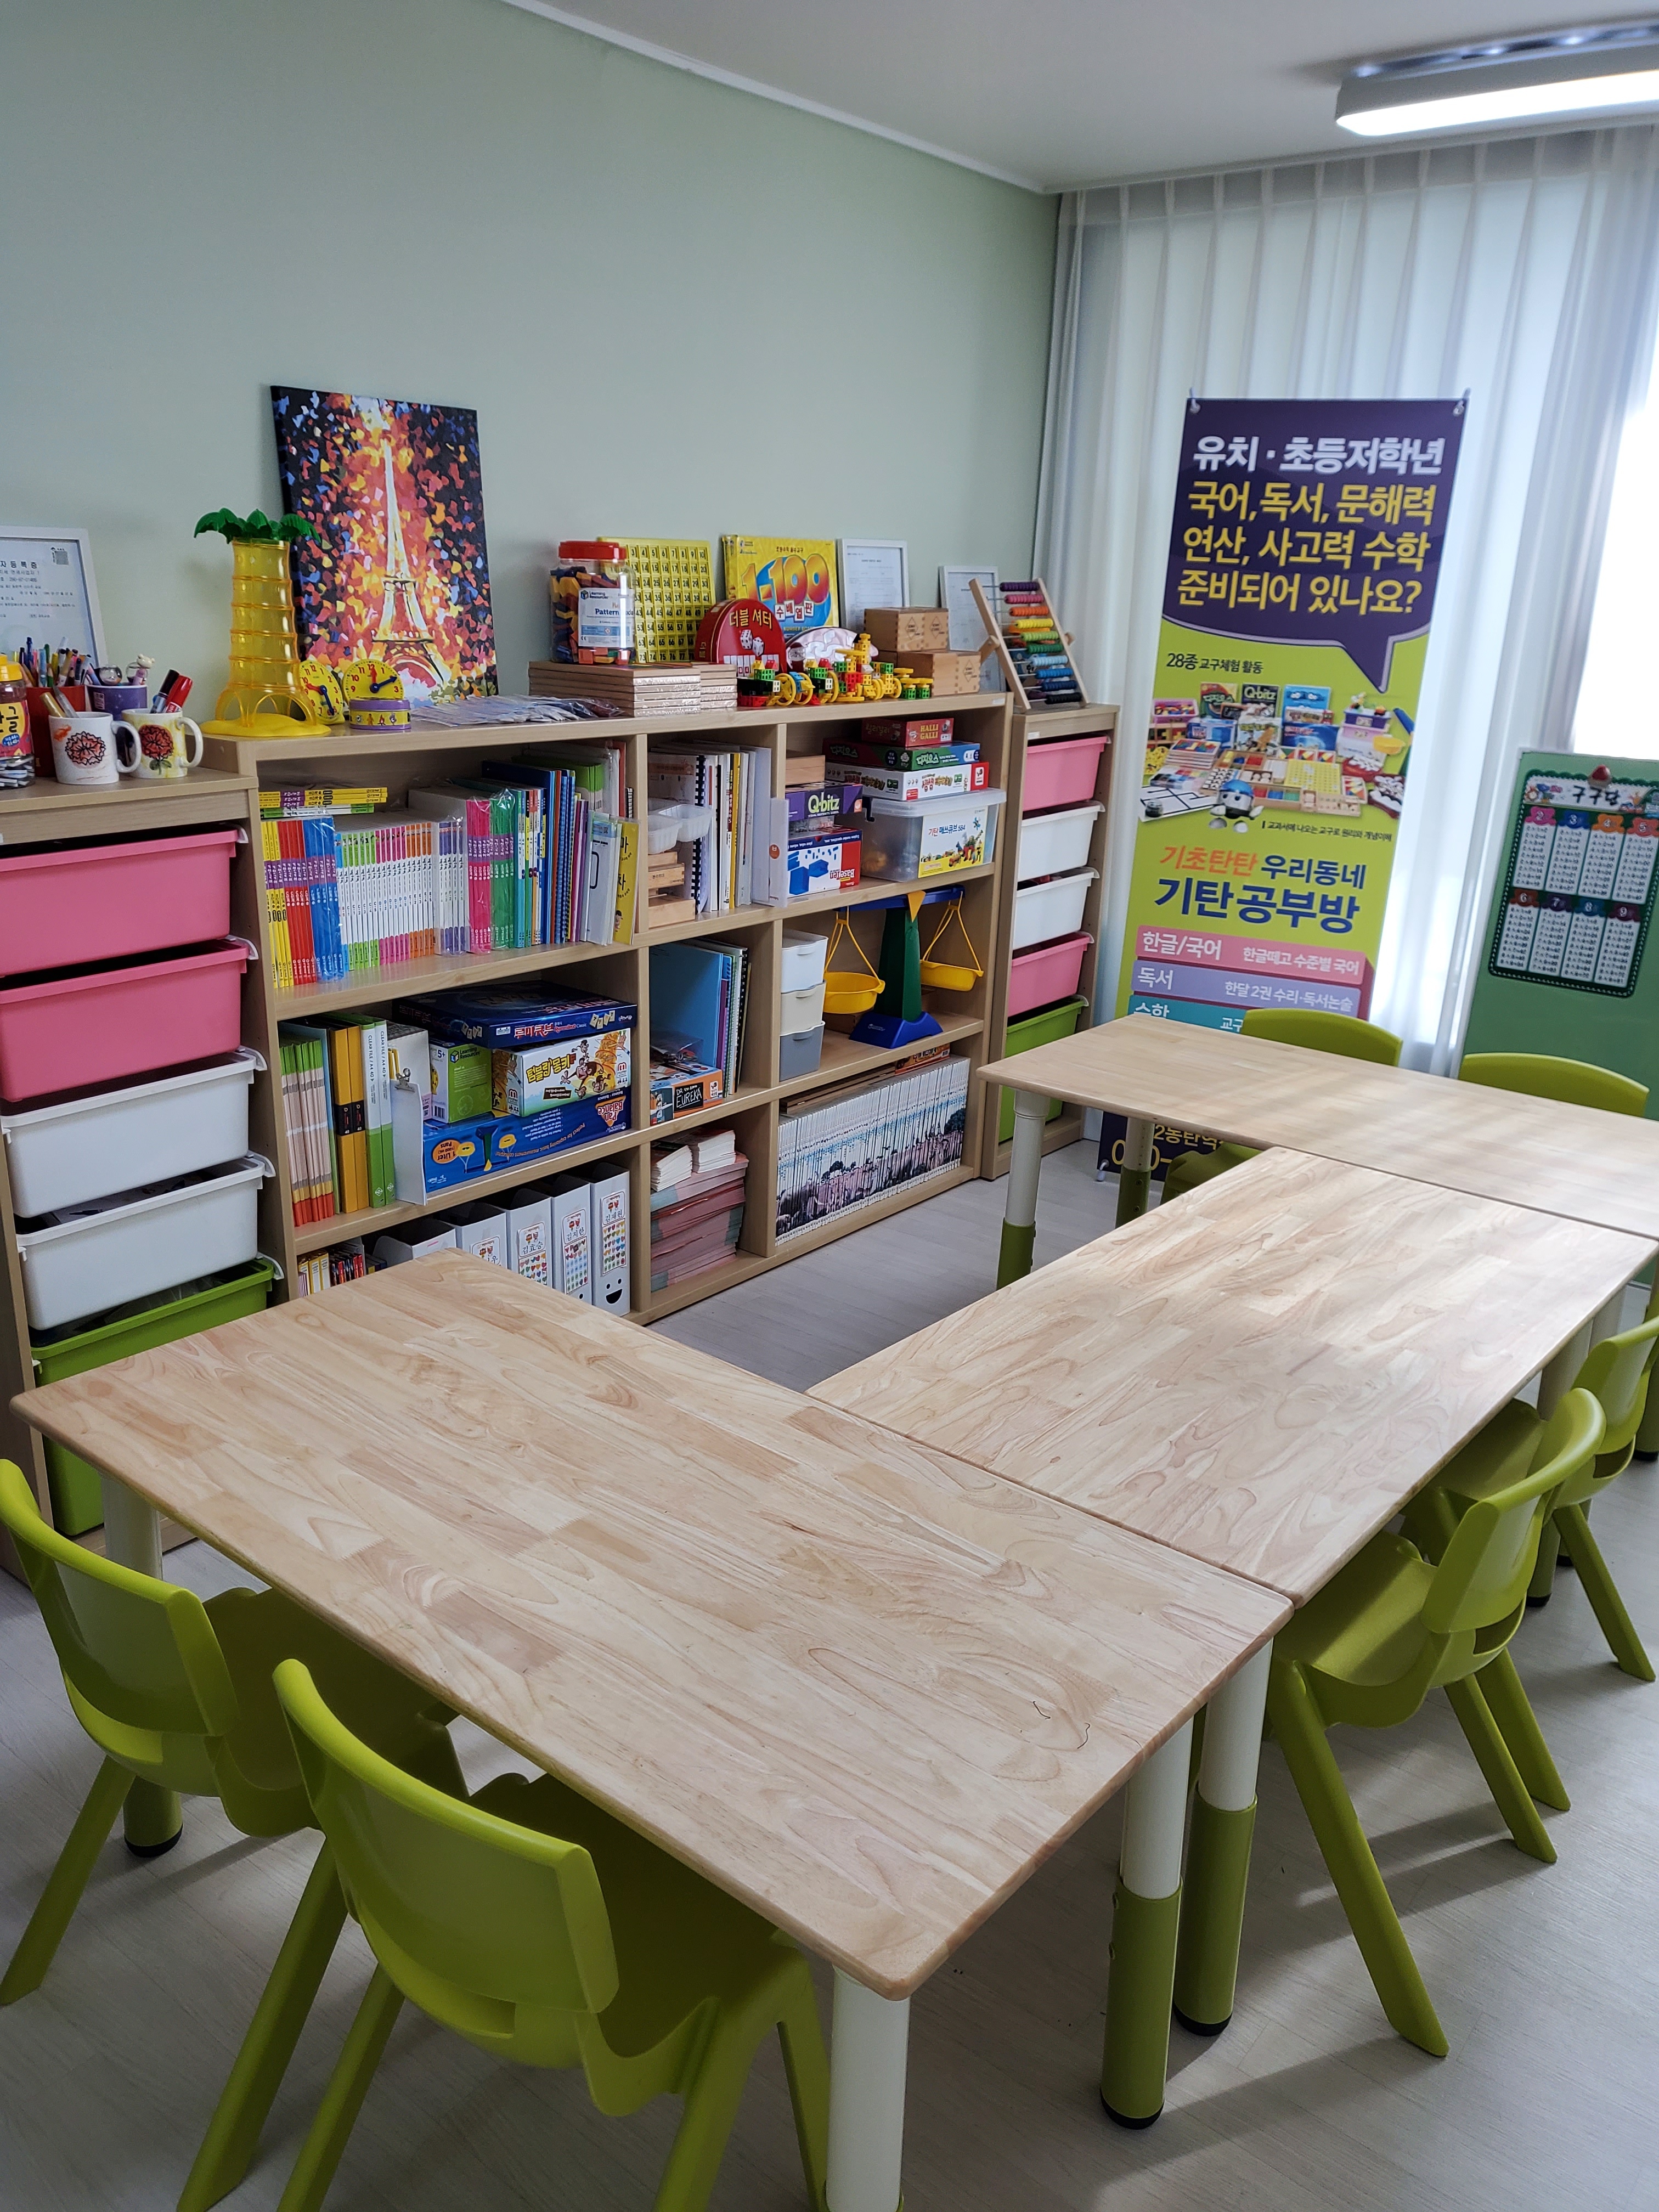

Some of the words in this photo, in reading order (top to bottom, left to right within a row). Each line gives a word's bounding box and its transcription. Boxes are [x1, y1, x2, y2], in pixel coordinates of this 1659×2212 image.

[1193, 436, 1259, 472] 유치
[1279, 436, 1445, 475] 초등저학년
[1336, 483, 1437, 525] 문해력
[651, 549, 656, 557] 5
[661, 549, 666, 557] 6
[671, 550, 675, 558] 7
[681, 550, 685, 558] 8
[690, 550, 695, 558] 9
[1259, 528, 1355, 569] 사고력
[1362, 531, 1431, 572] 수학
[641, 563, 648, 572] 14
[651, 564, 658, 572] 15
[642, 579, 650, 587] 24
[692, 580, 698, 588] 29
[644, 594, 651, 602] 34
[1177, 570, 1301, 611] 준비되어
[1309, 574, 1423, 615] 있나요?
[635, 608, 642, 617] 43
[646, 608, 653, 617] 44
[729, 608, 749, 628] 더블
[752, 609, 772, 629] 셔터
[638, 639, 645, 647] 63
[1166, 653, 1198, 670] 28종
[920, 724, 939, 732] HALLI
[920, 732, 938, 740] GALLI
[928, 827, 939, 837] 기탄
[1159, 845, 1258, 877] 기초탄탄
[1261, 854, 1367, 890] 우리동네
[1142, 931, 1222, 960] 한글/국어
[1293, 953, 1332, 973] 수준별
[1333, 959, 1359, 975] 국어
[1137, 967, 1173, 990] 독서
[1224, 981, 1250, 997] 한달
[1251, 986, 1272, 1000] 2권
[514, 1023, 554, 1039] 루미큐브
[460, 1051, 480, 1059] Resources
[526, 1058, 552, 1084] 텀블링
[552, 1054, 571, 1074] 몽키
[676, 1087, 702, 1108] EUREKA
[597, 1101, 623, 1115] Balance
[605, 1111, 617, 1121] Pan
[437, 1152, 451, 1160] Liter
[566, 1228, 585, 1241] 김지한
